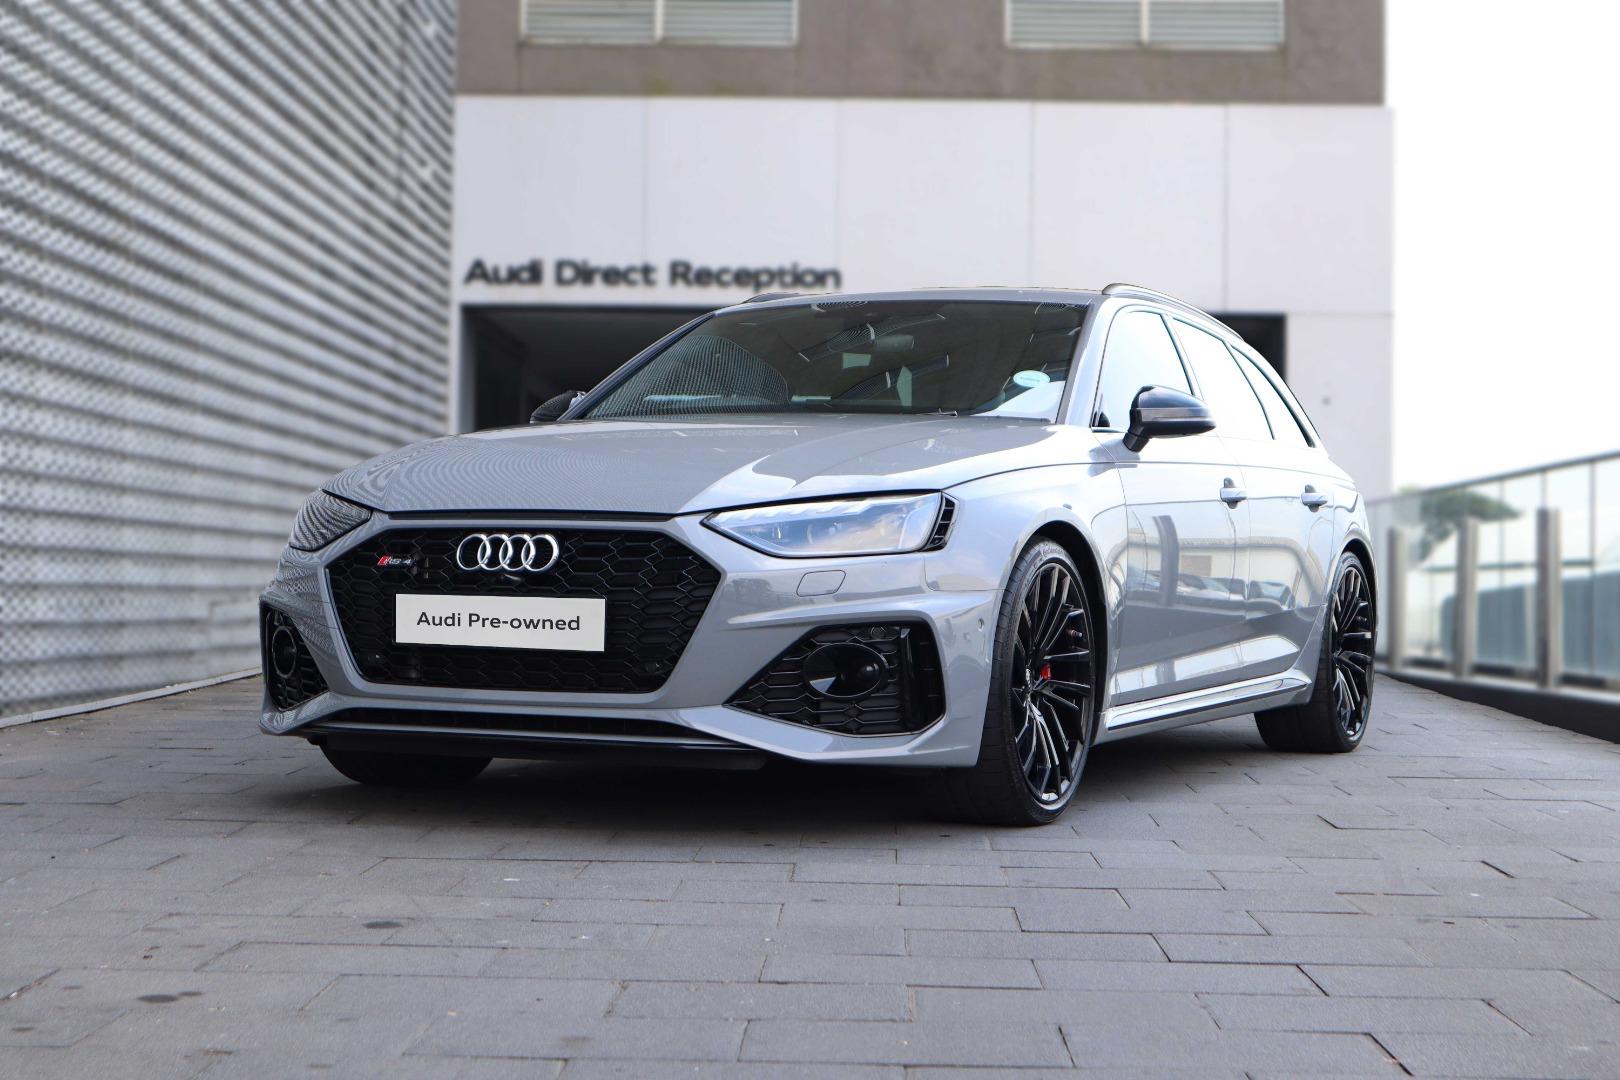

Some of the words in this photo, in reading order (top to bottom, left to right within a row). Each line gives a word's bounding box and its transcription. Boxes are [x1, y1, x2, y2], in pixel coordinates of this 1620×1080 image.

[463, 259, 544, 286] Audi
[554, 259, 657, 287] Direct
[669, 260, 842, 292] Reception
[416, 612, 461, 628] Audi
[468, 612, 580, 631] Pre-owned
